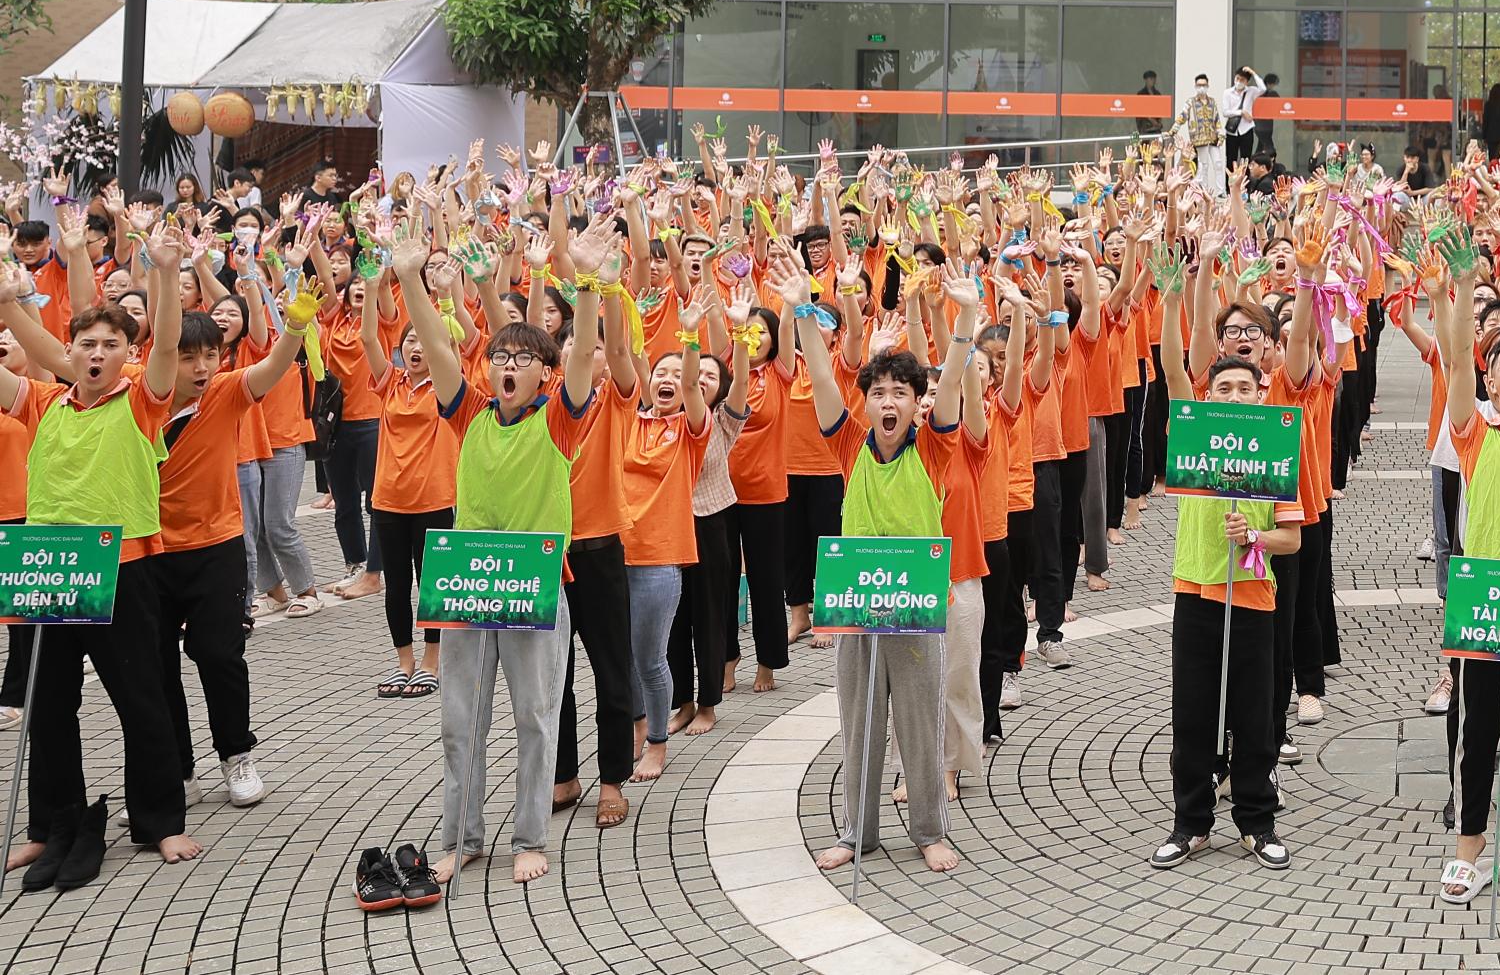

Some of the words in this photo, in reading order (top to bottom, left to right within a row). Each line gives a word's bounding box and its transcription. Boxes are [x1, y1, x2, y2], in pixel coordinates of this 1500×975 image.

[1210, 432, 1243, 455] ĐỘI
[1248, 438, 1259, 452] 6
[1176, 452, 1219, 475] LUẬT
[1223, 458, 1267, 475] KINH
[1271, 456, 1294, 477] TẾ
[21, 548, 54, 569] ĐỘI
[59, 552, 78, 566] 12
[469, 555, 501, 575] ĐỘI
[507, 559, 514, 572] 1
[0, 570, 65, 586] HƯƠNG
[69, 572, 102, 590] MẠI
[435, 574, 489, 592] CÔNG
[493, 576, 541, 597] NGHỆ
[858, 567, 892, 590] ĐỘI
[896, 571, 908, 586] 4
[12, 589, 52, 610] ĐIỆN
[56, 588, 78, 606] TỬ
[442, 595, 503, 612] THÔNG
[508, 599, 534, 613] TIN
[824, 586, 865, 609] ĐIỀU
[870, 590, 938, 609] DƯỠNG
[1472, 603, 1497, 622] TÀI
[1447, 865, 1476, 882] NER
